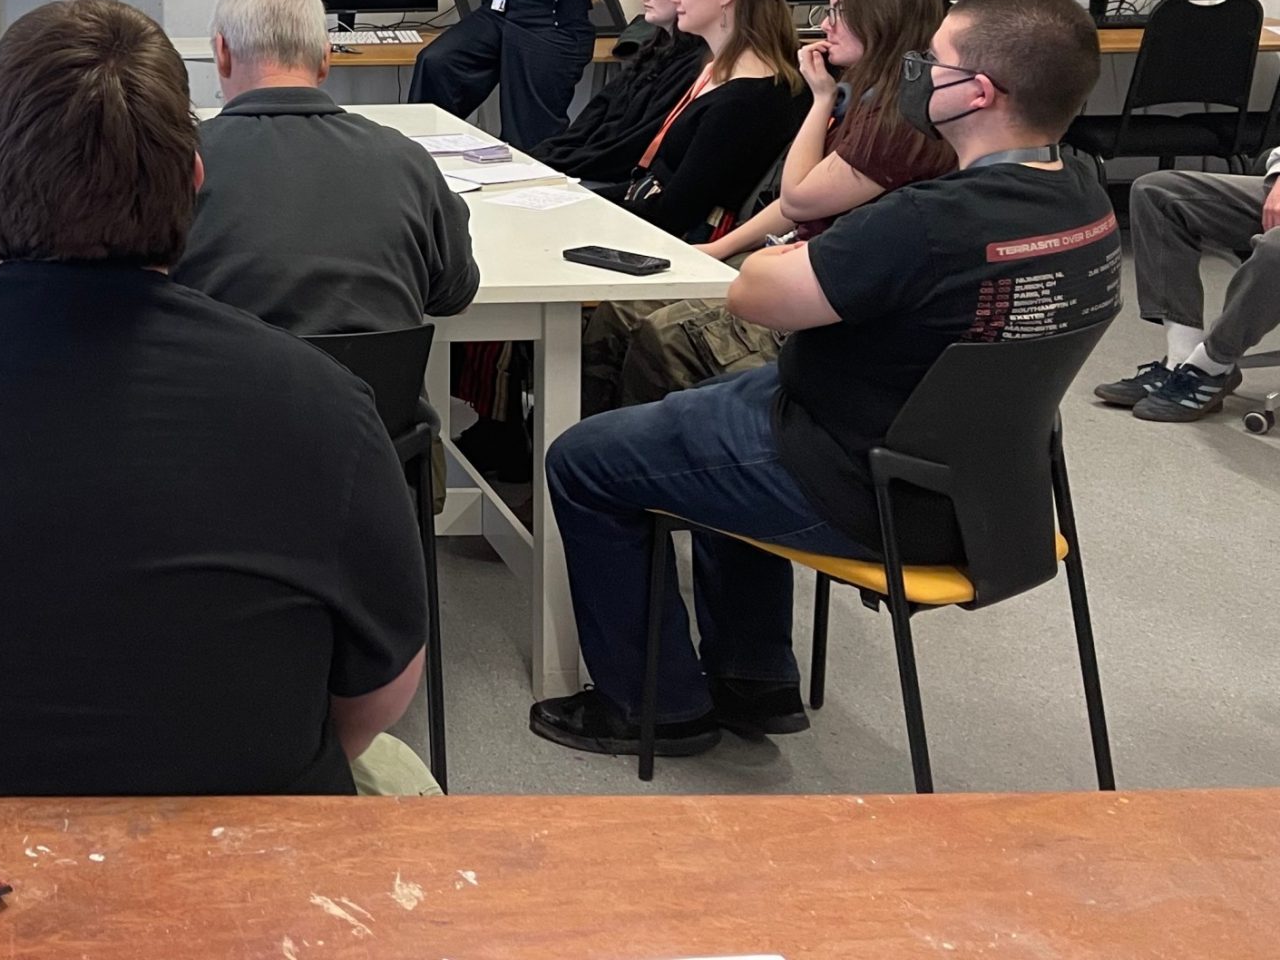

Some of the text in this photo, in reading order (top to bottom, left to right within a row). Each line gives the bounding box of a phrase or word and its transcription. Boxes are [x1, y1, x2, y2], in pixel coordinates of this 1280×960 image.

[996, 238, 1060, 256] TERRASITE
[1062, 231, 1084, 245] OVER
[1085, 222, 1109, 239] EUROPE
